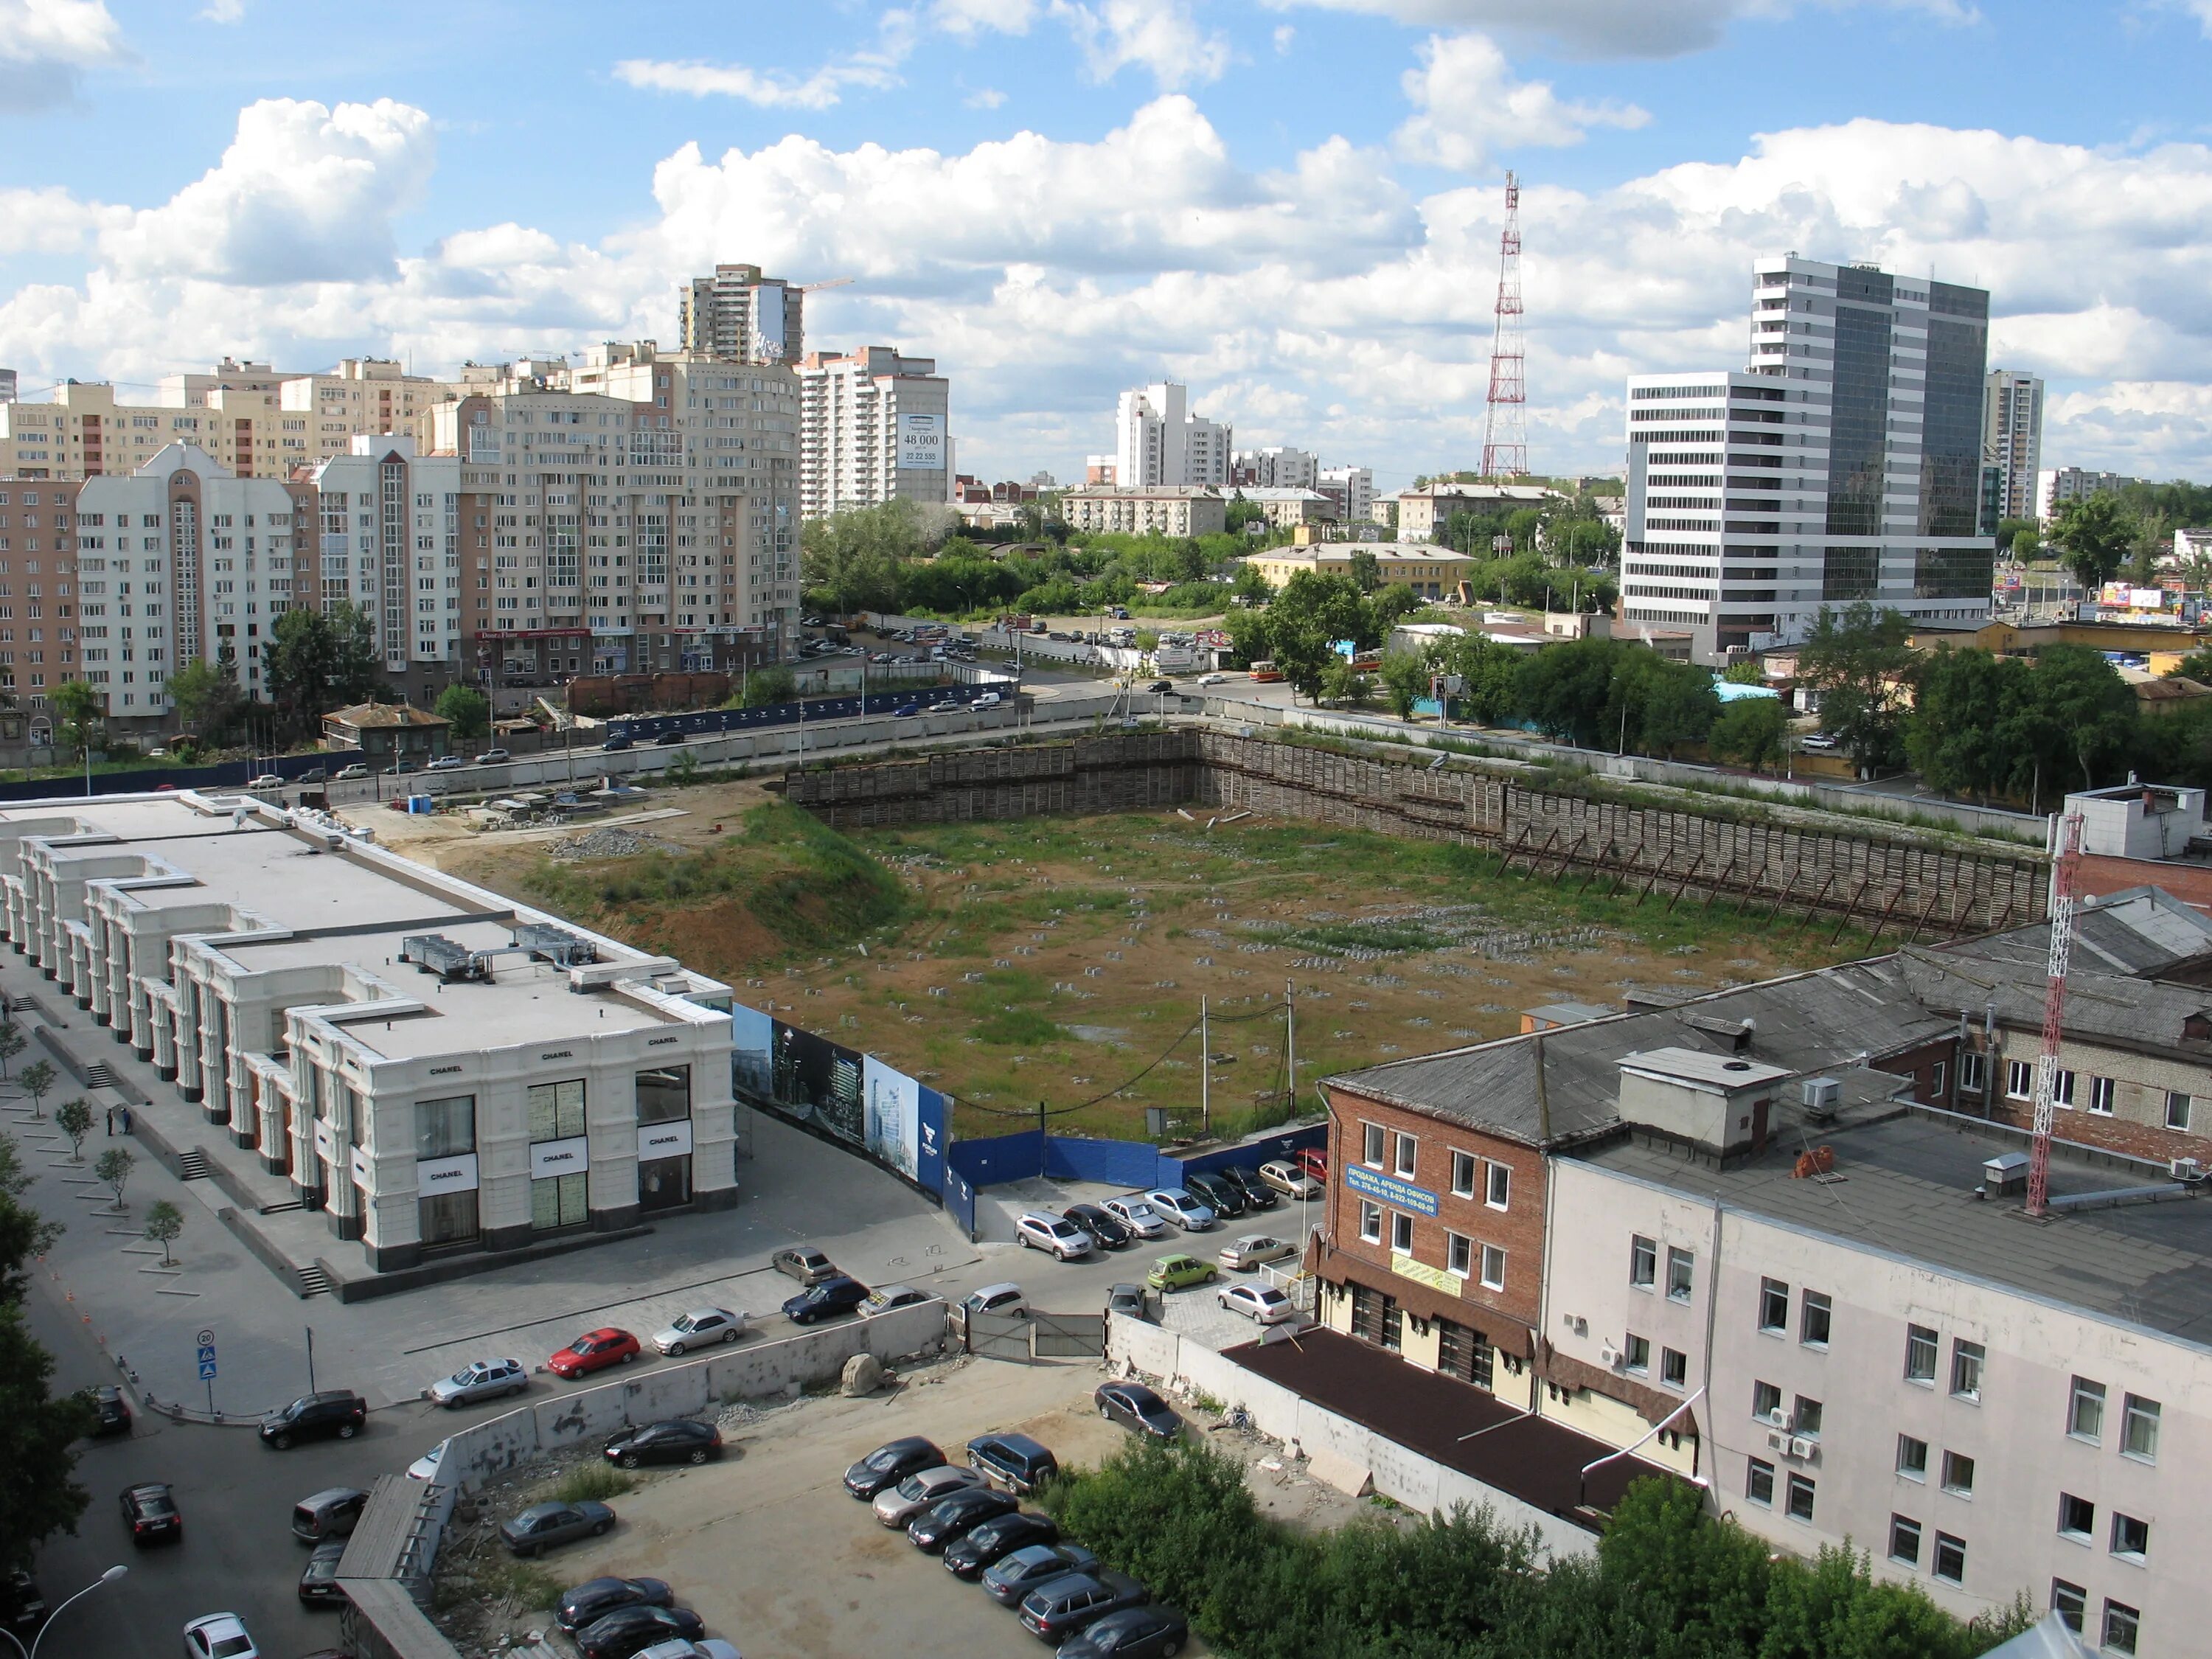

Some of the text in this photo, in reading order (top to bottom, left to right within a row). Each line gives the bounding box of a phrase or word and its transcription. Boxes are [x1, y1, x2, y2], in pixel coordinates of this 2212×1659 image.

[904, 435, 938, 445] 48 000
[649, 1037, 678, 1046] CHANEL
[542, 1051, 573, 1060] CHANEL
[430, 1065, 463, 1075] CHANEL
[649, 1135, 678, 1145] CHANEL
[543, 1152, 573, 1163] CHANEL
[431, 1170, 463, 1180] CHANEL
[1348, 1167, 1435, 1204] ПРОДАЖА, АРЕНДА ОФИСОВ
